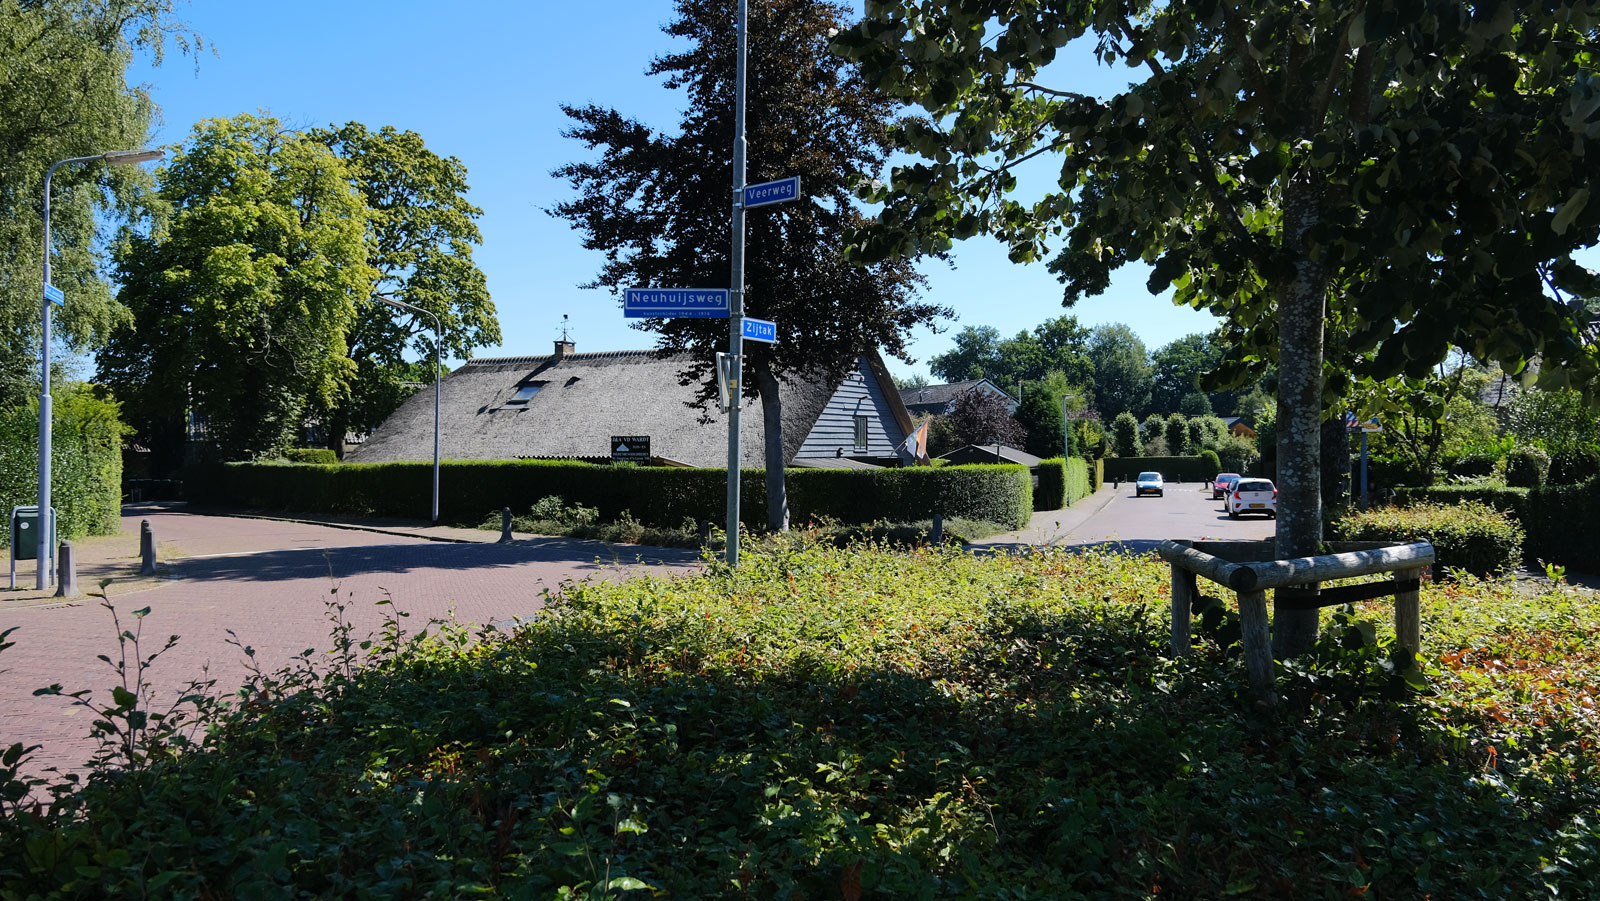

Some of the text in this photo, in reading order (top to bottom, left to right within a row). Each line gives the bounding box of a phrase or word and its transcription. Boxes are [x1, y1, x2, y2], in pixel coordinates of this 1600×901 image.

[749, 184, 792, 199] Veerweg
[631, 292, 722, 306] Neuhuijsweg
[746, 322, 772, 336] Zijtak
